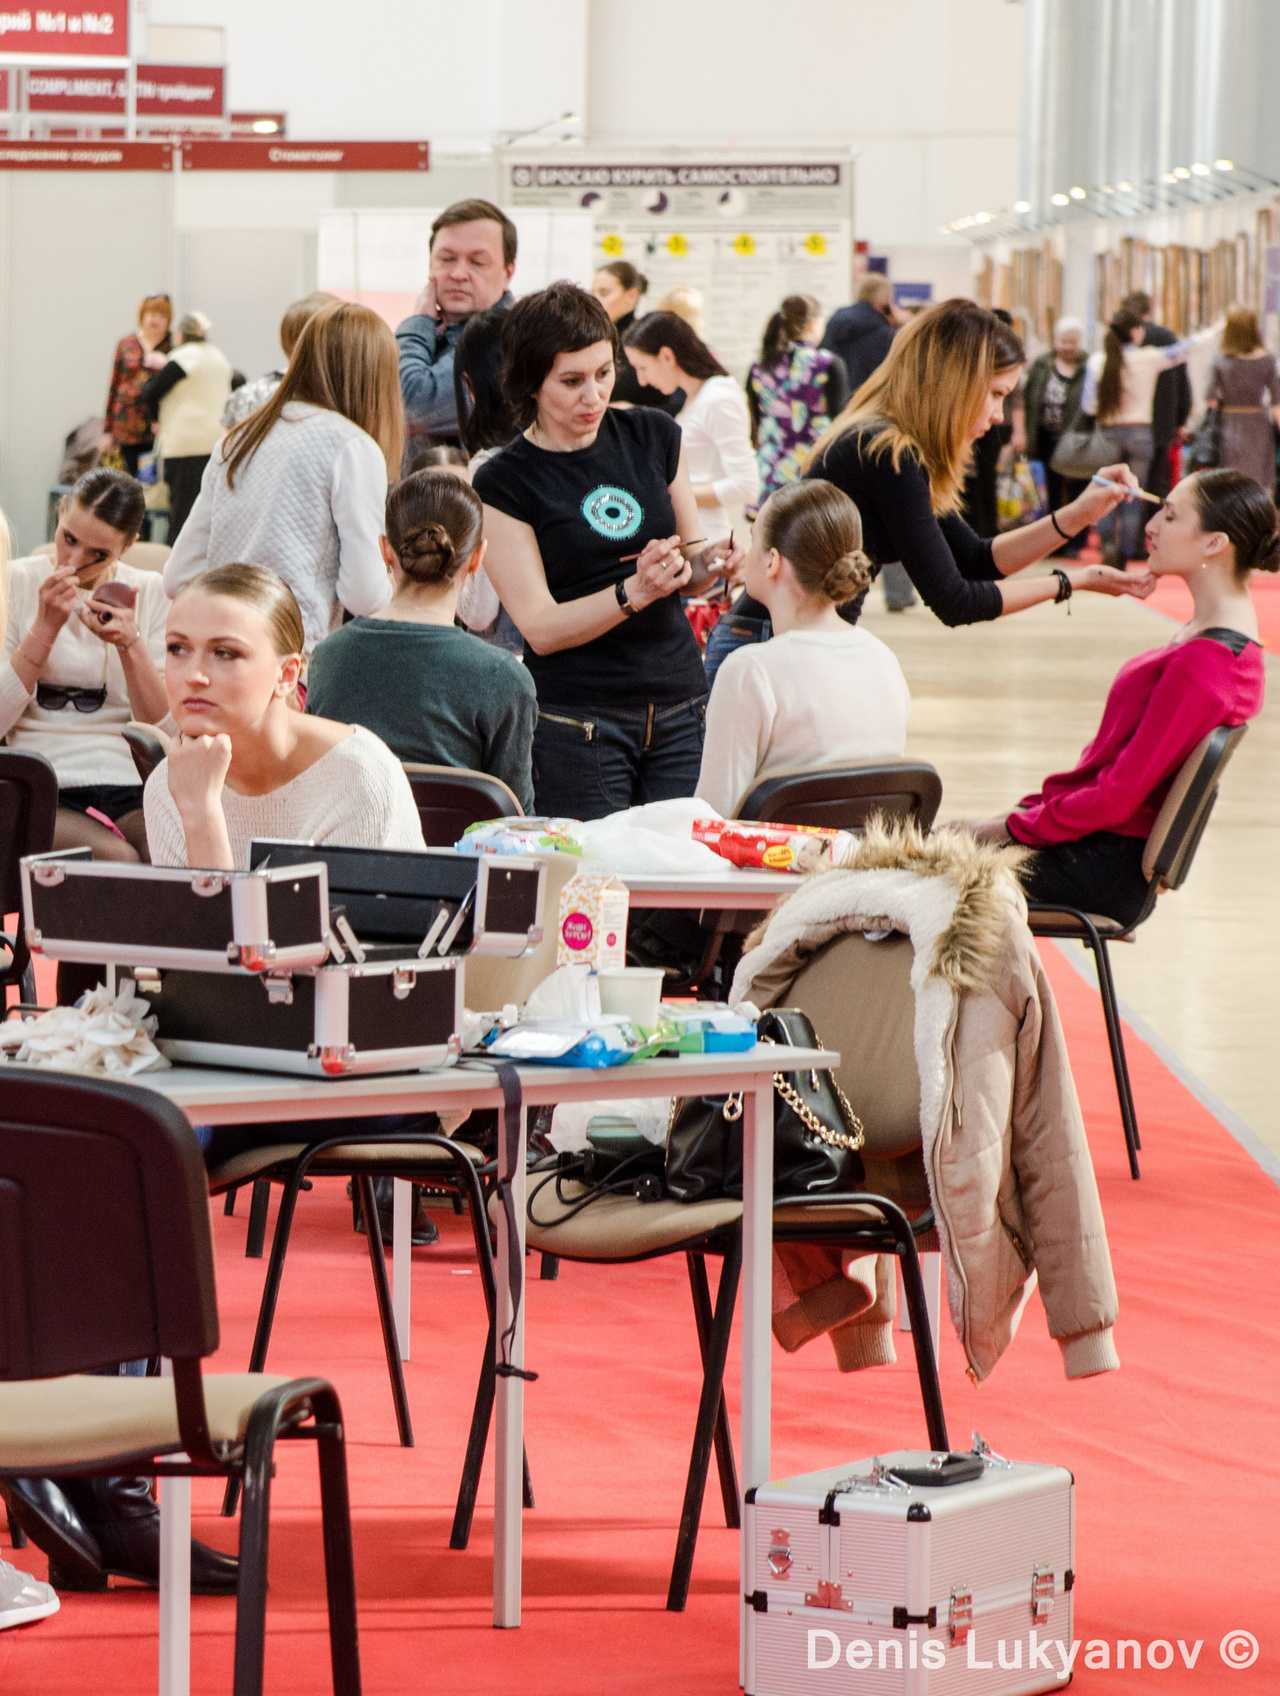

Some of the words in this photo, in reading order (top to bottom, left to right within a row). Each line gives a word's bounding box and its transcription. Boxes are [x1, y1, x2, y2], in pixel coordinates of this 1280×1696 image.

[36, 11, 67, 33] №1
[68, 15, 82, 33] и
[82, 13, 114, 35] №2
[538, 168, 611, 185] БРОСАЮ
[612, 168, 676, 185] КУРИТЬ
[677, 167, 837, 185] САМОСТОЯТЕЛЬНО
